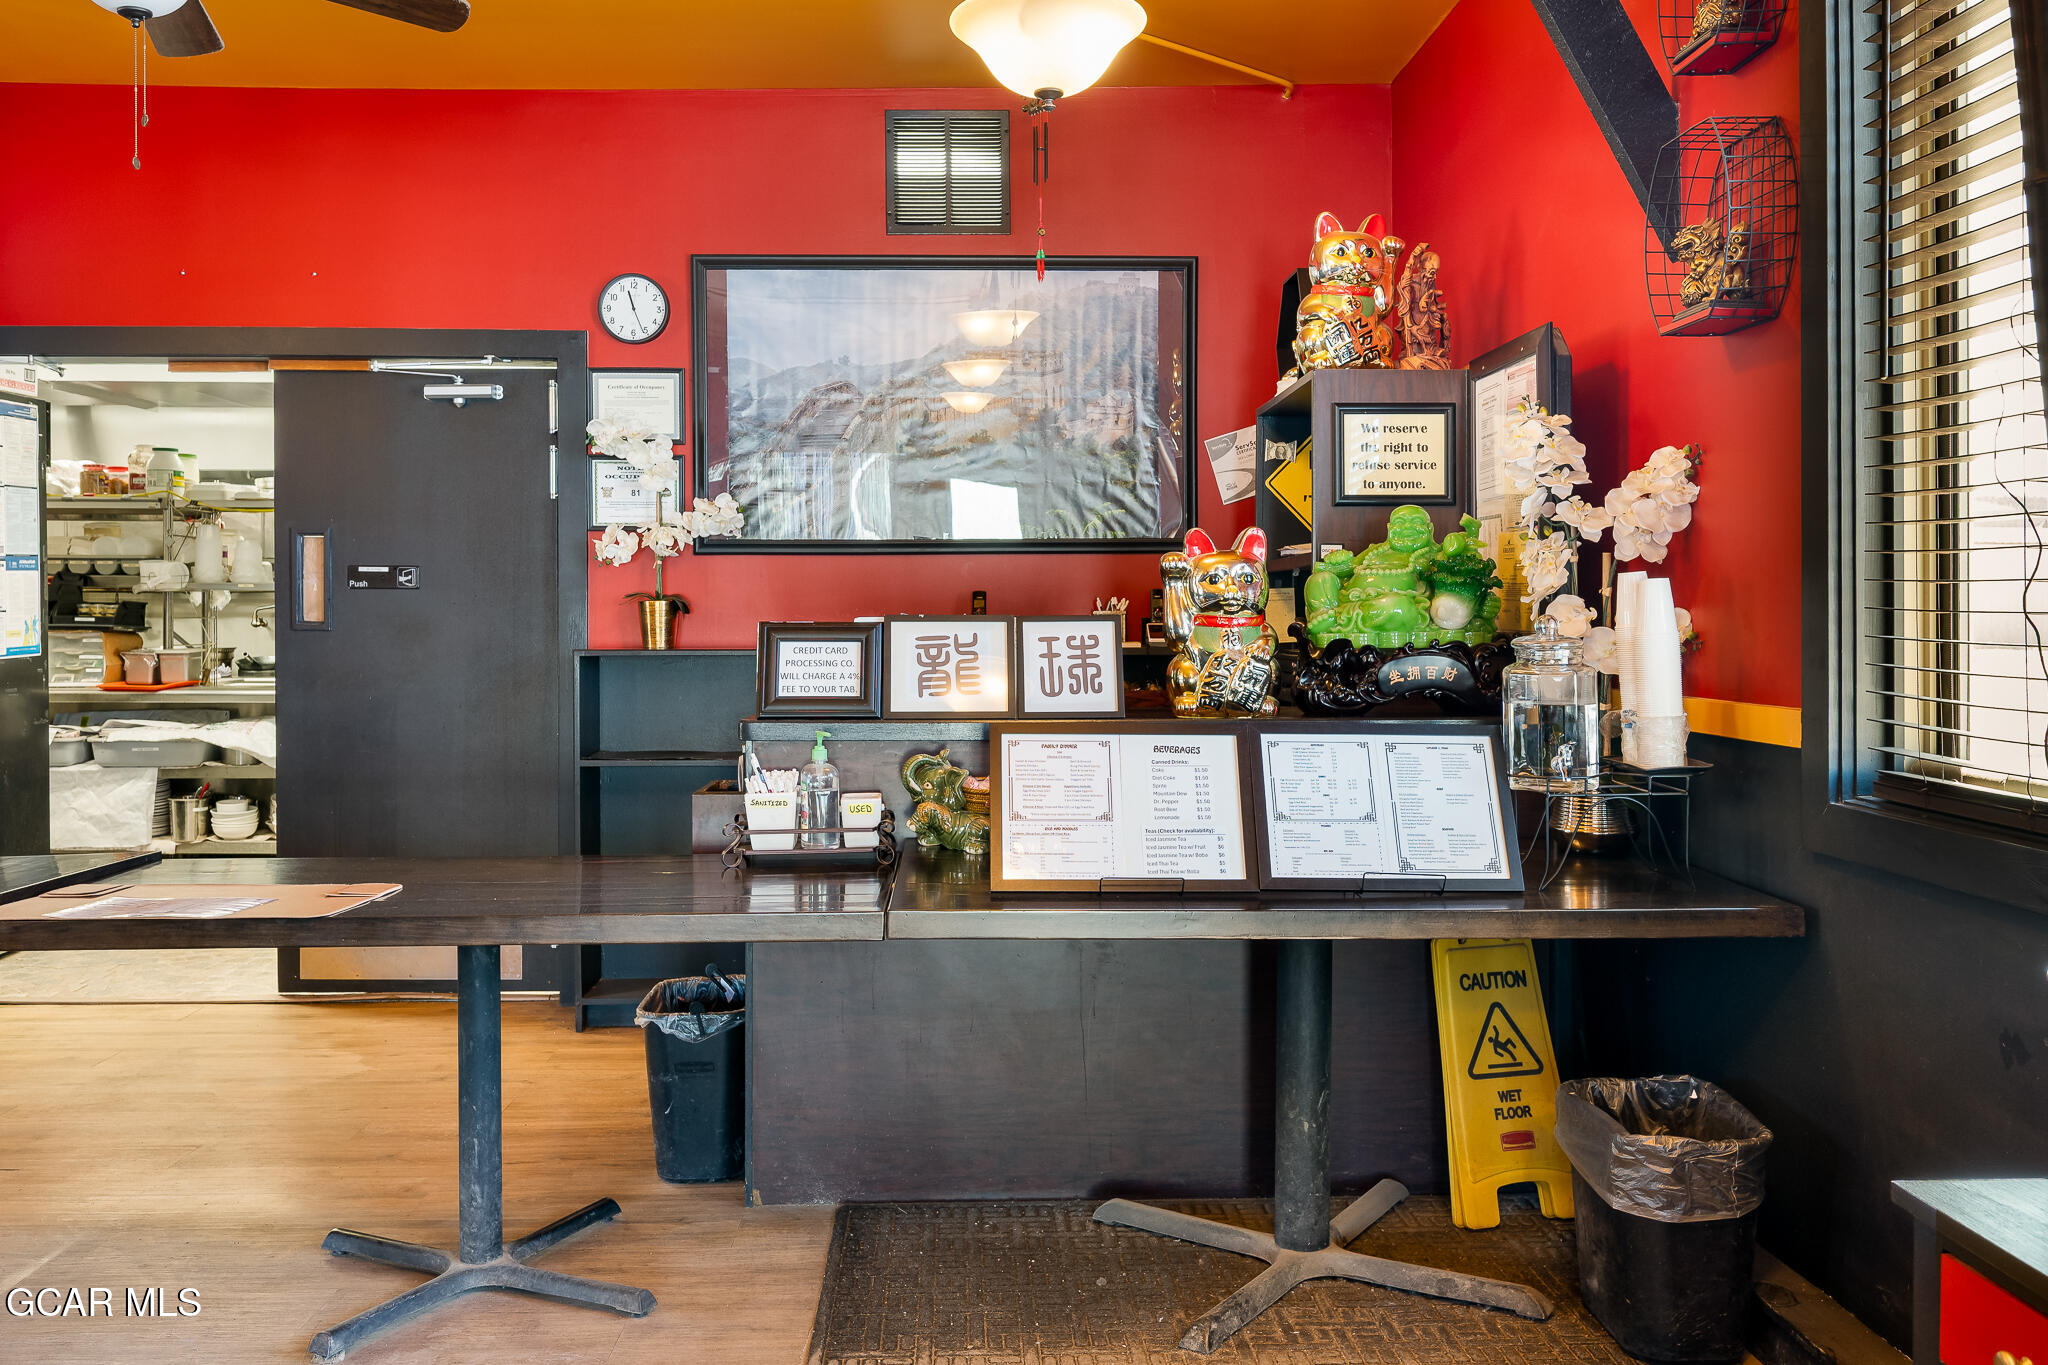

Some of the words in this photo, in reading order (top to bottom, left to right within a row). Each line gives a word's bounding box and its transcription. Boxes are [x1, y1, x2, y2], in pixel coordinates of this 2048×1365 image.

[630, 281, 638, 289] 12
[610, 293, 618, 301] 10
[652, 294, 658, 302] 2
[656, 306, 662, 314] 3
[619, 325, 624, 333] 7
[1361, 423, 1379, 433] We
[1383, 425, 1428, 433] reserve
[1235, 440, 1257, 450] ServSa
[1383, 442, 1413, 455] right
[1417, 442, 1429, 452] to
[1352, 460, 1391, 470] refuse
[1394, 460, 1437, 470] service
[1363, 480, 1375, 489] to
[1379, 480, 1426, 491] anyone.
[631, 489, 640, 497] 81
[349, 580, 368, 588] Push
[792, 646, 823, 655] CREDIT
[824, 646, 849, 655] CARD
[785, 659, 838, 667] PROCESSING
[840, 659, 855, 667] CO.
[780, 672, 801, 680] WILL
[802, 672, 838, 680] CHARGE
[839, 672, 845, 680] A
[781, 685, 796, 693] FEE
[799, 685, 811, 693] TO
[812, 685, 837, 693] YOUR
[839, 685, 858, 694] TAB.
[1153, 745, 1201, 755] BEVERAGES
[849, 804, 873, 813] USED
[1459, 969, 1528, 992] CAUTION
[1497, 1089, 1522, 1103] WET
[1494, 1105, 1533, 1121] FLOOR
